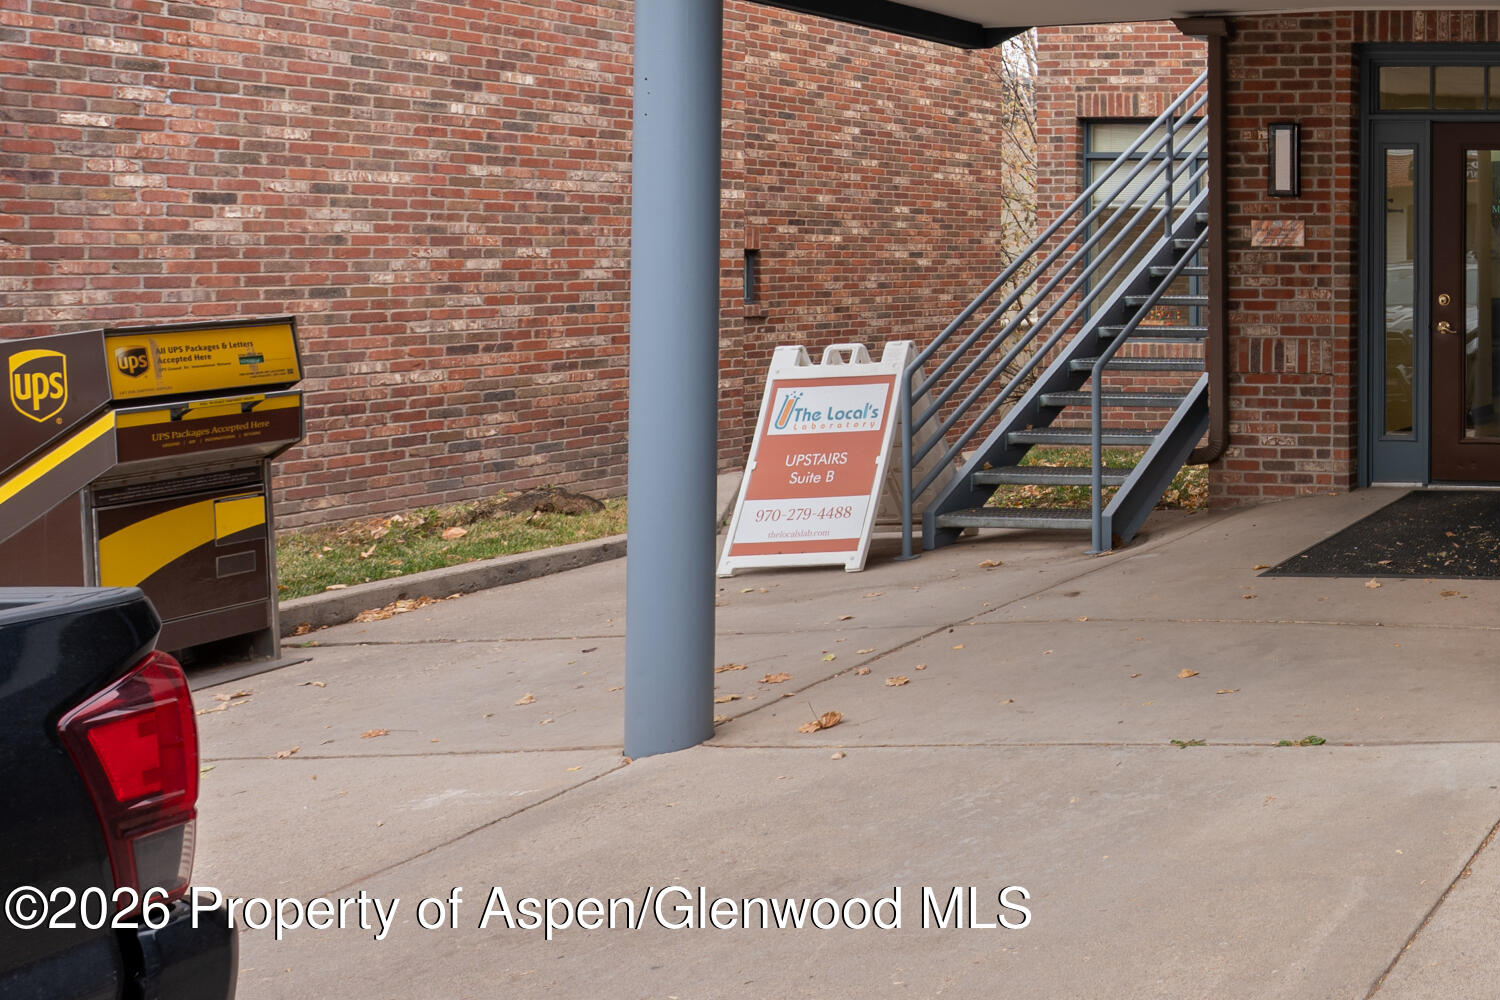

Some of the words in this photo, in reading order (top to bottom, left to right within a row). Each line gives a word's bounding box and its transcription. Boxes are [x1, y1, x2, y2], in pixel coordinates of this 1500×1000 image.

[168, 345, 183, 354] UPS
[185, 344, 220, 352] Packages
[228, 341, 254, 349] Letters
[157, 355, 192, 364] Accepted
[14, 372, 64, 411] ups
[794, 407, 822, 422] The
[827, 402, 879, 420] Local's
[152, 431, 170, 442] UPS
[171, 427, 210, 439] Packages
[211, 422, 249, 435] Accepted
[251, 419, 270, 429] Here
[793, 421, 876, 431] Laboratory
[785, 452, 848, 467] UPSTAIRS
[789, 471, 822, 485] Suite
[825, 470, 835, 483] B
[755, 506, 852, 523] 970-279-4488
